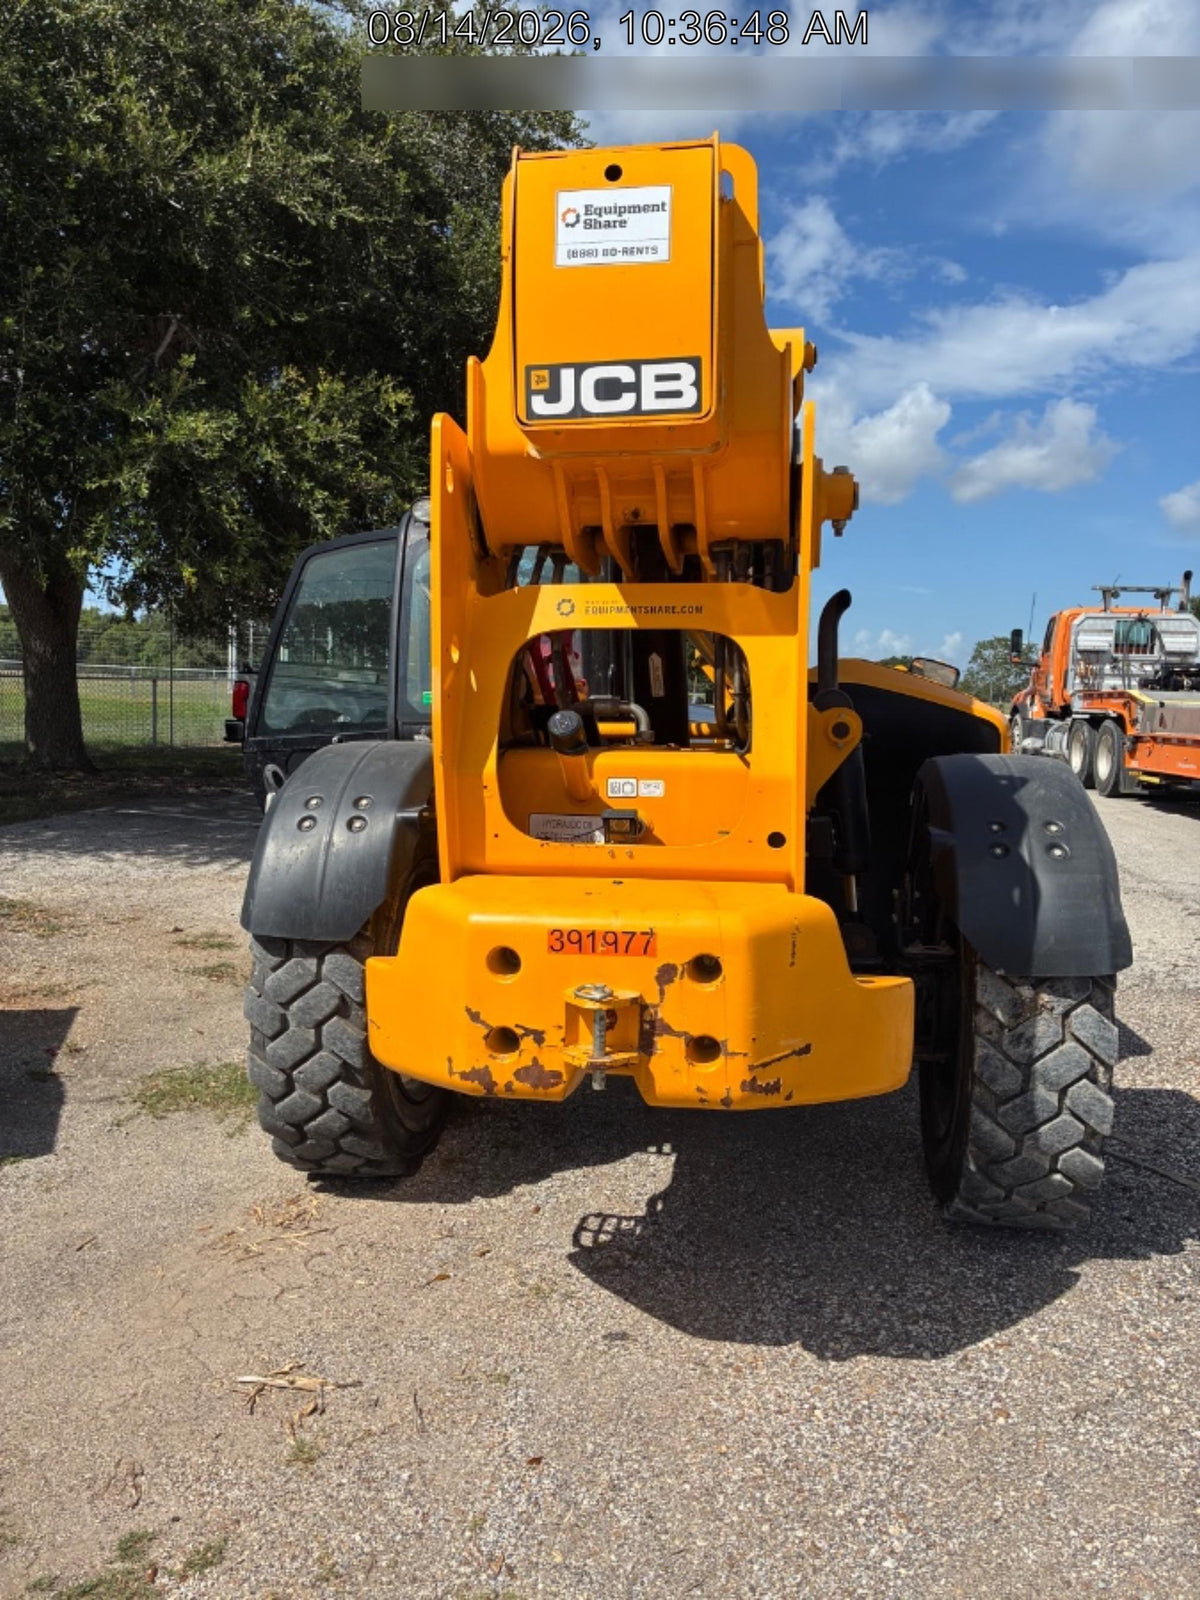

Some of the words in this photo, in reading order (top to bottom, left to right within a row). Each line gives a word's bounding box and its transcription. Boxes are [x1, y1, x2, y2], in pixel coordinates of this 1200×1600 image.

[583, 201, 667, 217] Equipment
[583, 218, 628, 230] Share
[531, 362, 698, 415] JCB
[549, 928, 654, 955] 391977
